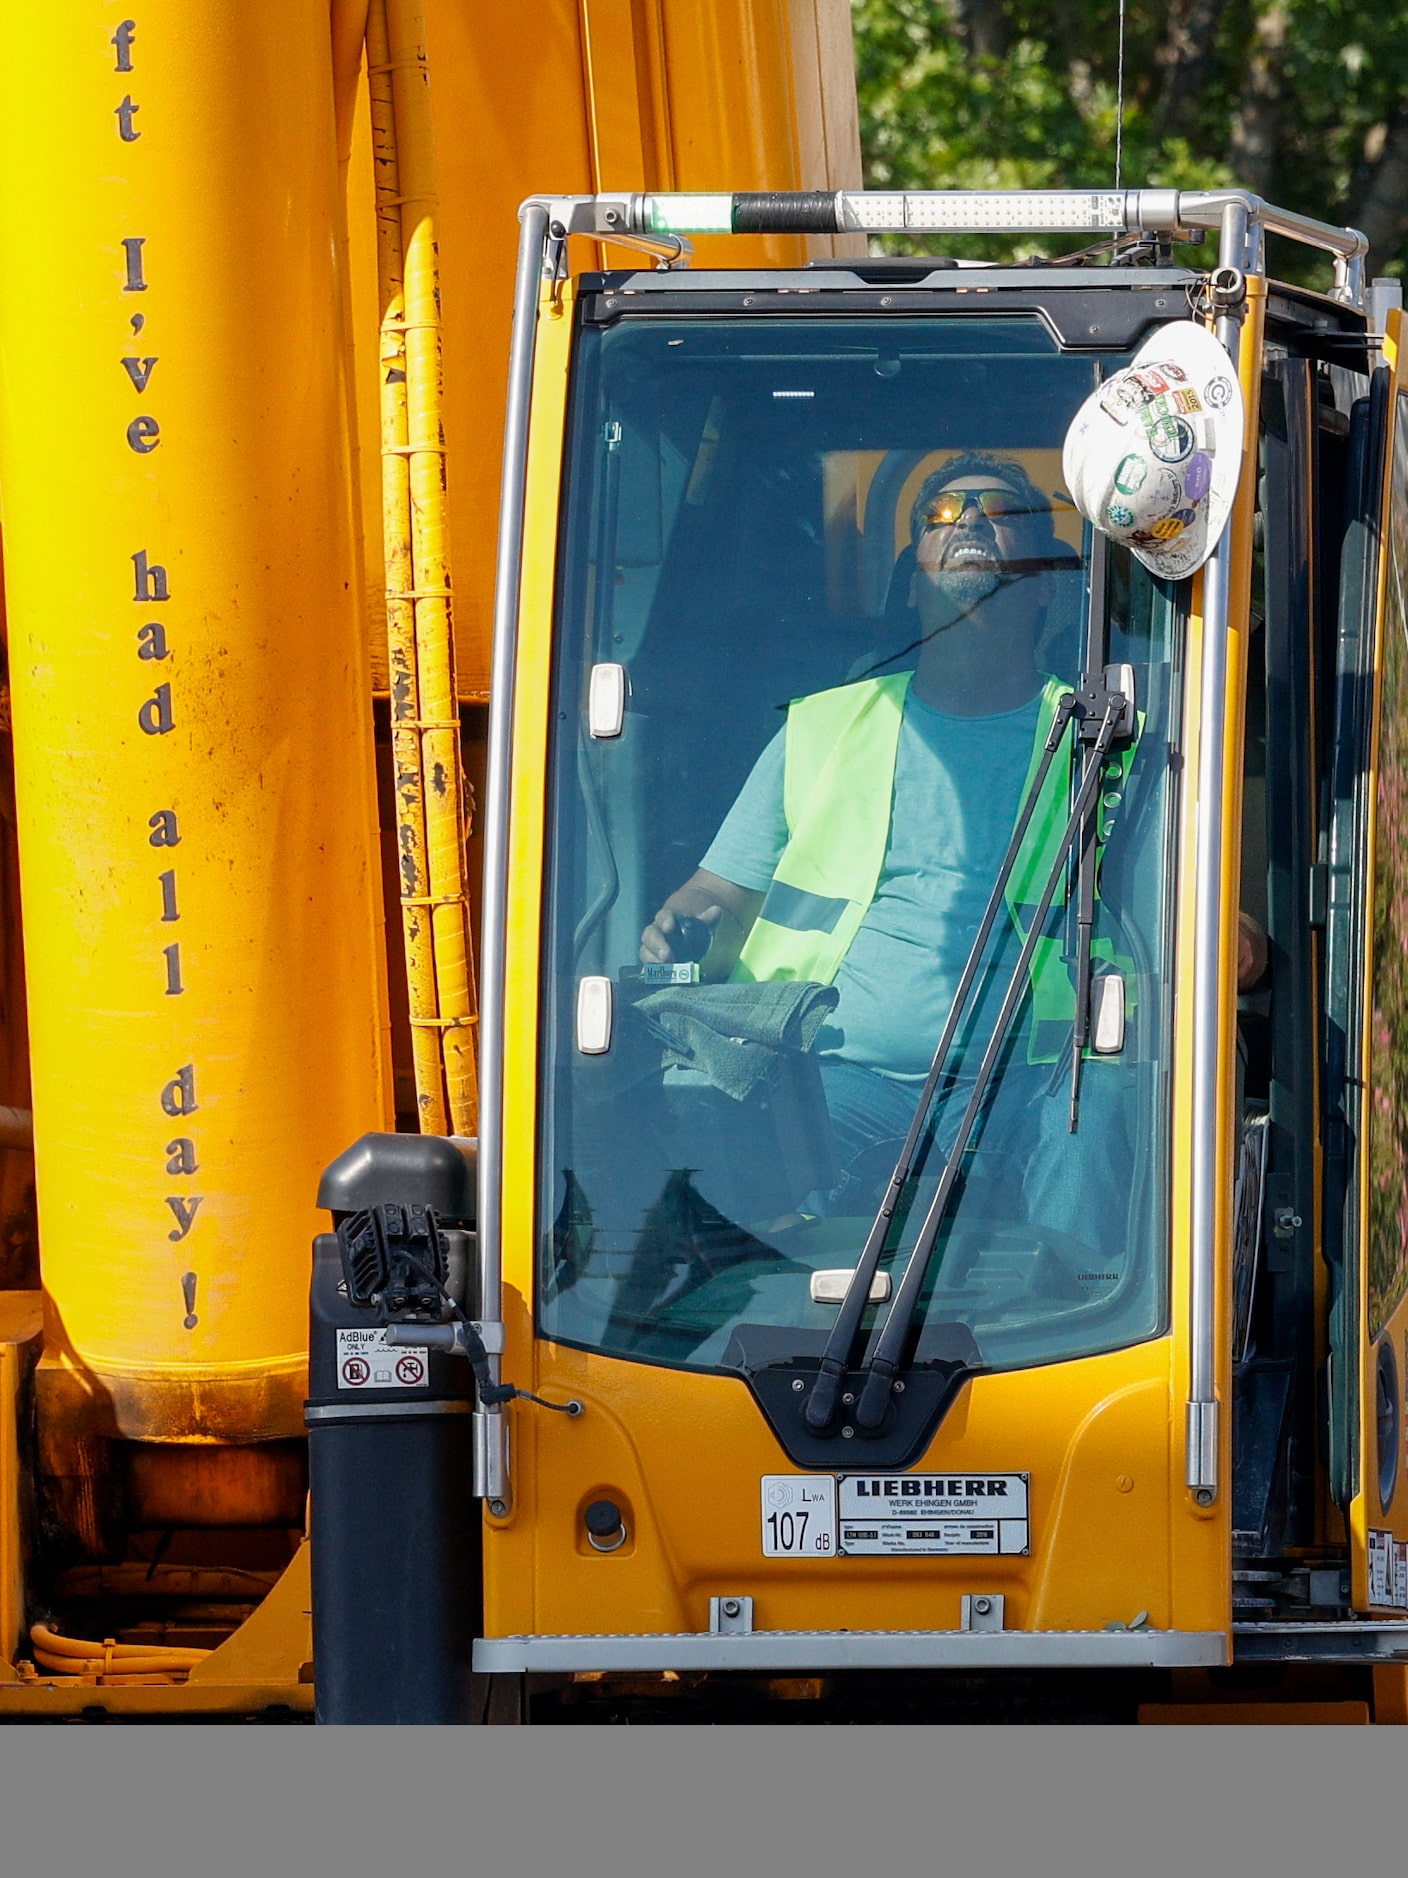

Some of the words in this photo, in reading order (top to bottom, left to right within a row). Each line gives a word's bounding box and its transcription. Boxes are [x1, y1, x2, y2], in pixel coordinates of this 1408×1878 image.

[119, 237, 161, 455] I've
[132, 550, 176, 735] had
[149, 809, 184, 996] all
[160, 1063, 204, 1331] day!
[347, 1343, 366, 1351] ONLY
[856, 1480, 1008, 1497] LIEBHERR
[888, 1499, 914, 1507] WERK
[915, 1499, 952, 1507] EHINGEN
[953, 1499, 978, 1507] GMBH
[767, 1512, 809, 1551] 107
[815, 1534, 830, 1551] dB
